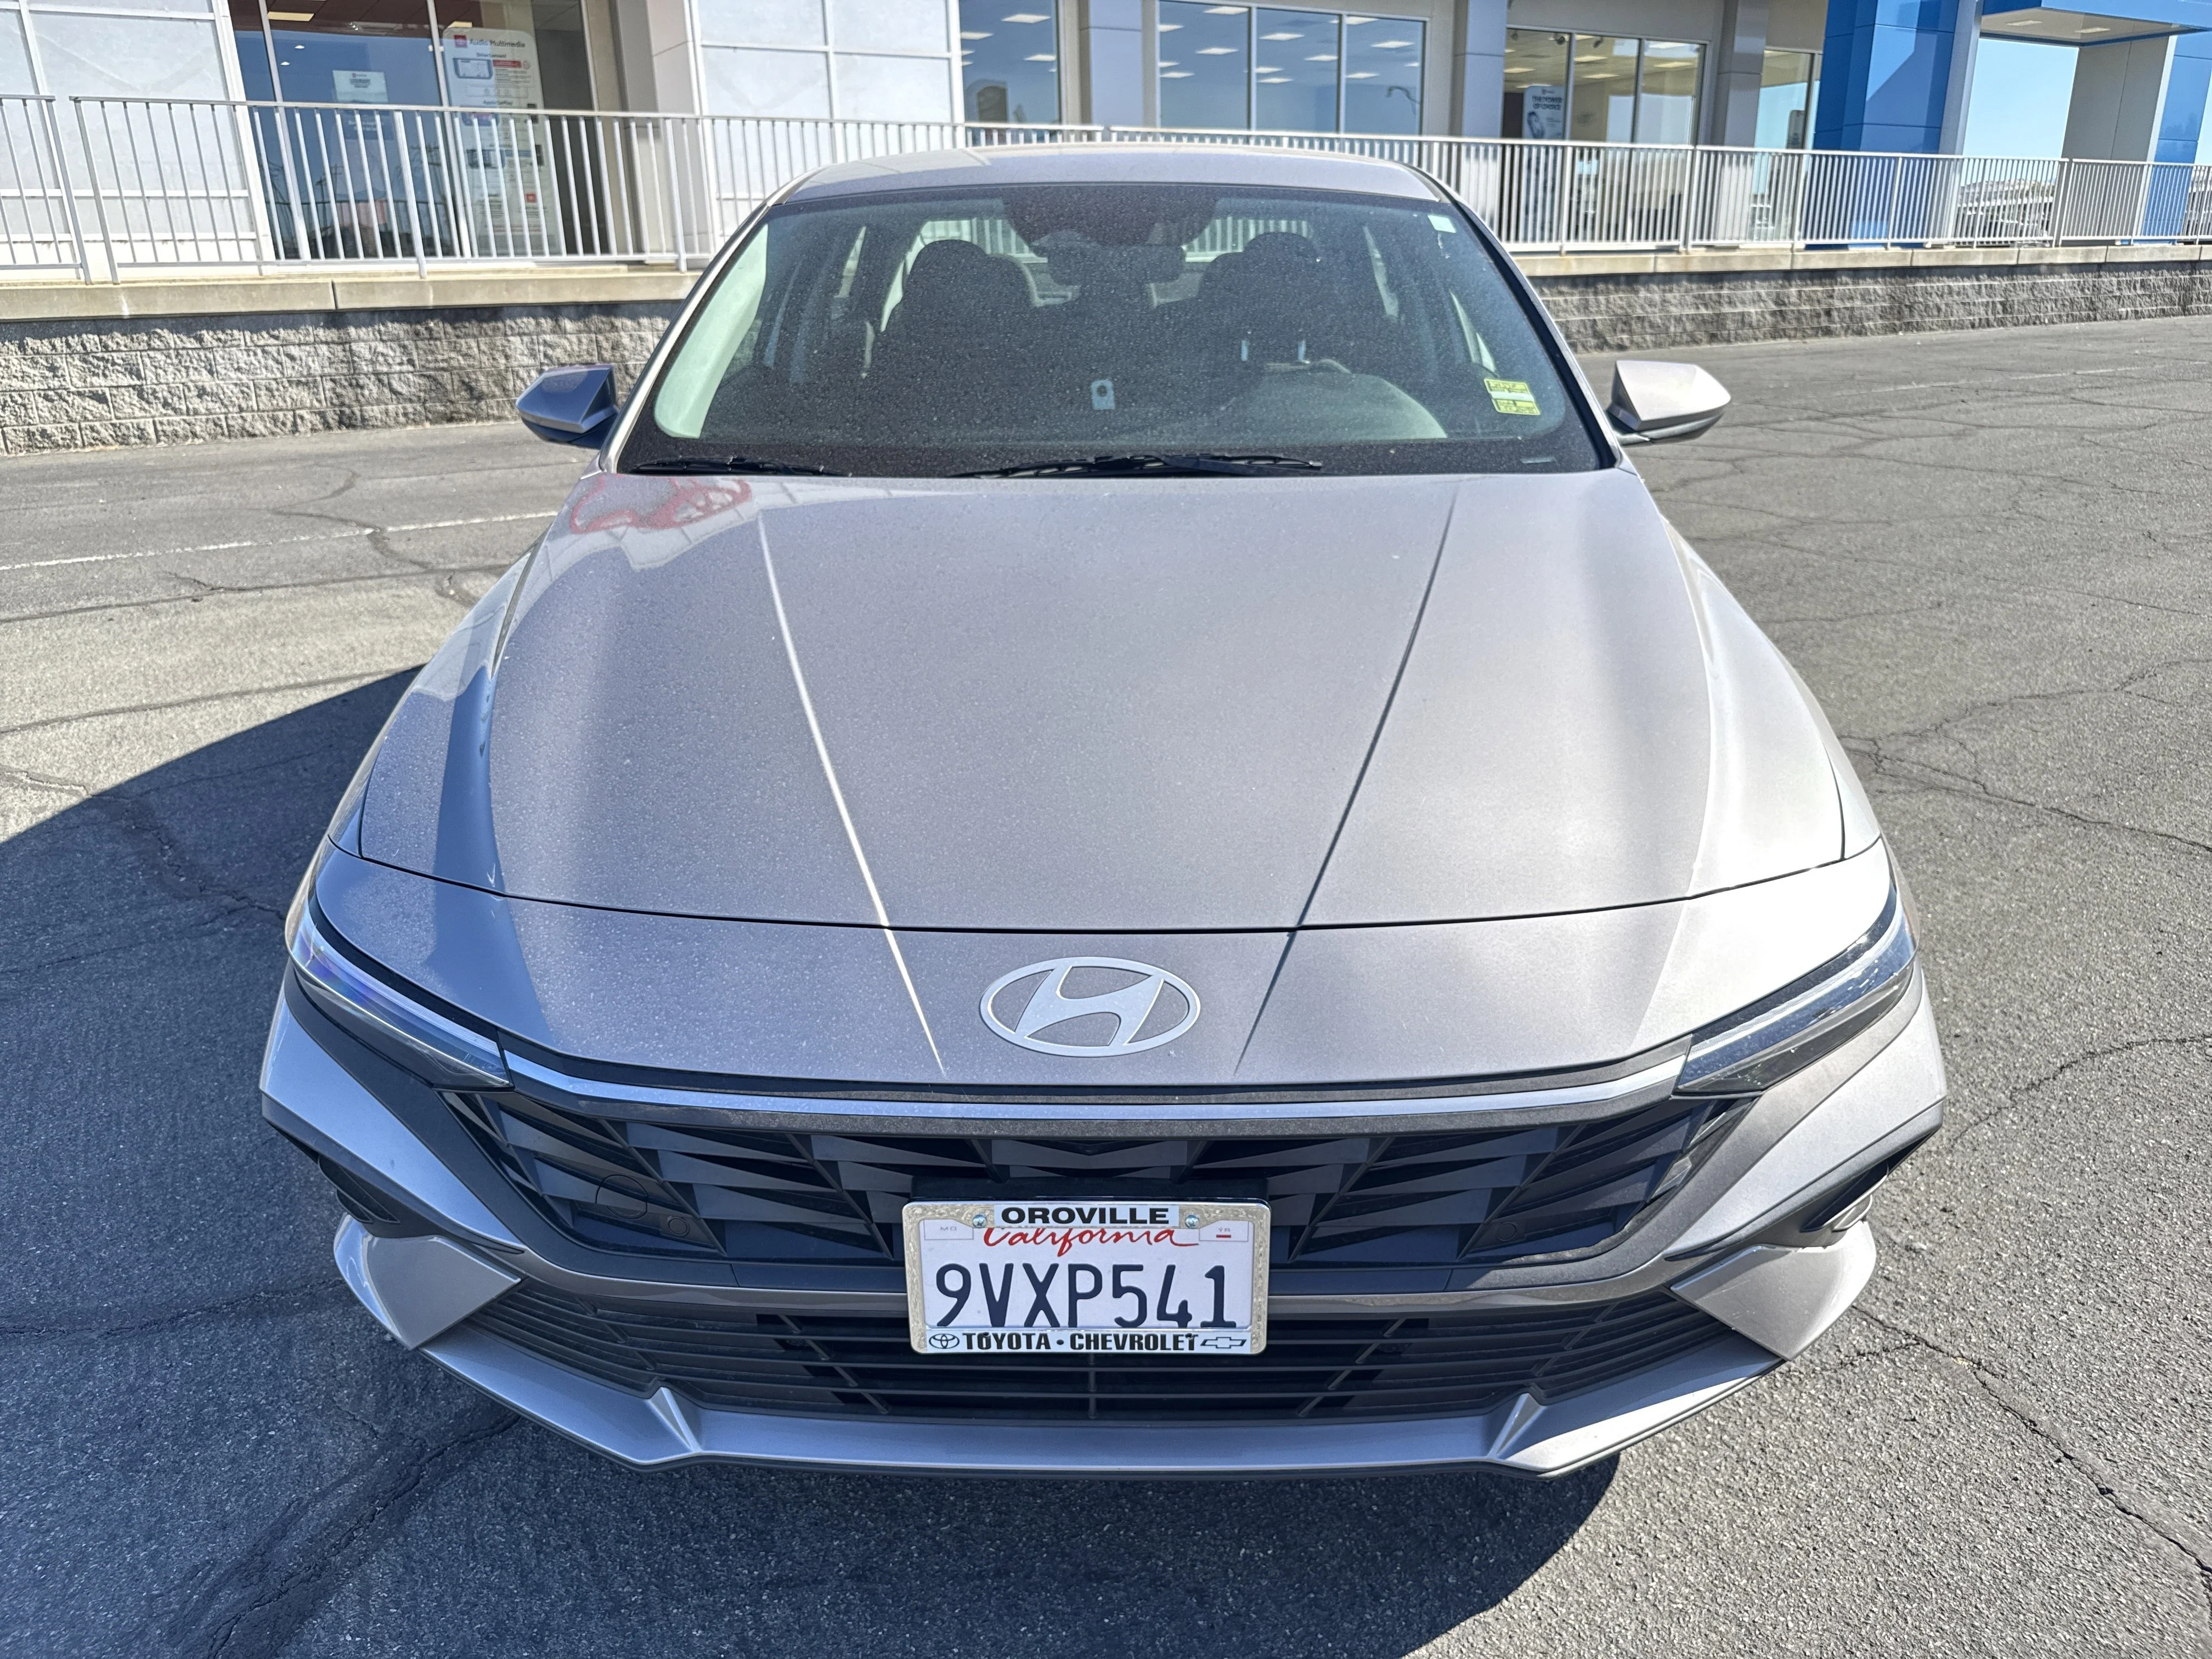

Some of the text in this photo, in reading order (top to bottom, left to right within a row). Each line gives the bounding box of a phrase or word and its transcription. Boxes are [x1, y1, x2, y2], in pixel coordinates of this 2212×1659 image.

[1001, 1207, 1169, 1224] OROVILLE
[984, 1228, 1200, 1257] California
[936, 1263, 1237, 1328] 9VXP541
[962, 1332, 1199, 1351] TOYOTA CHEVROLET
